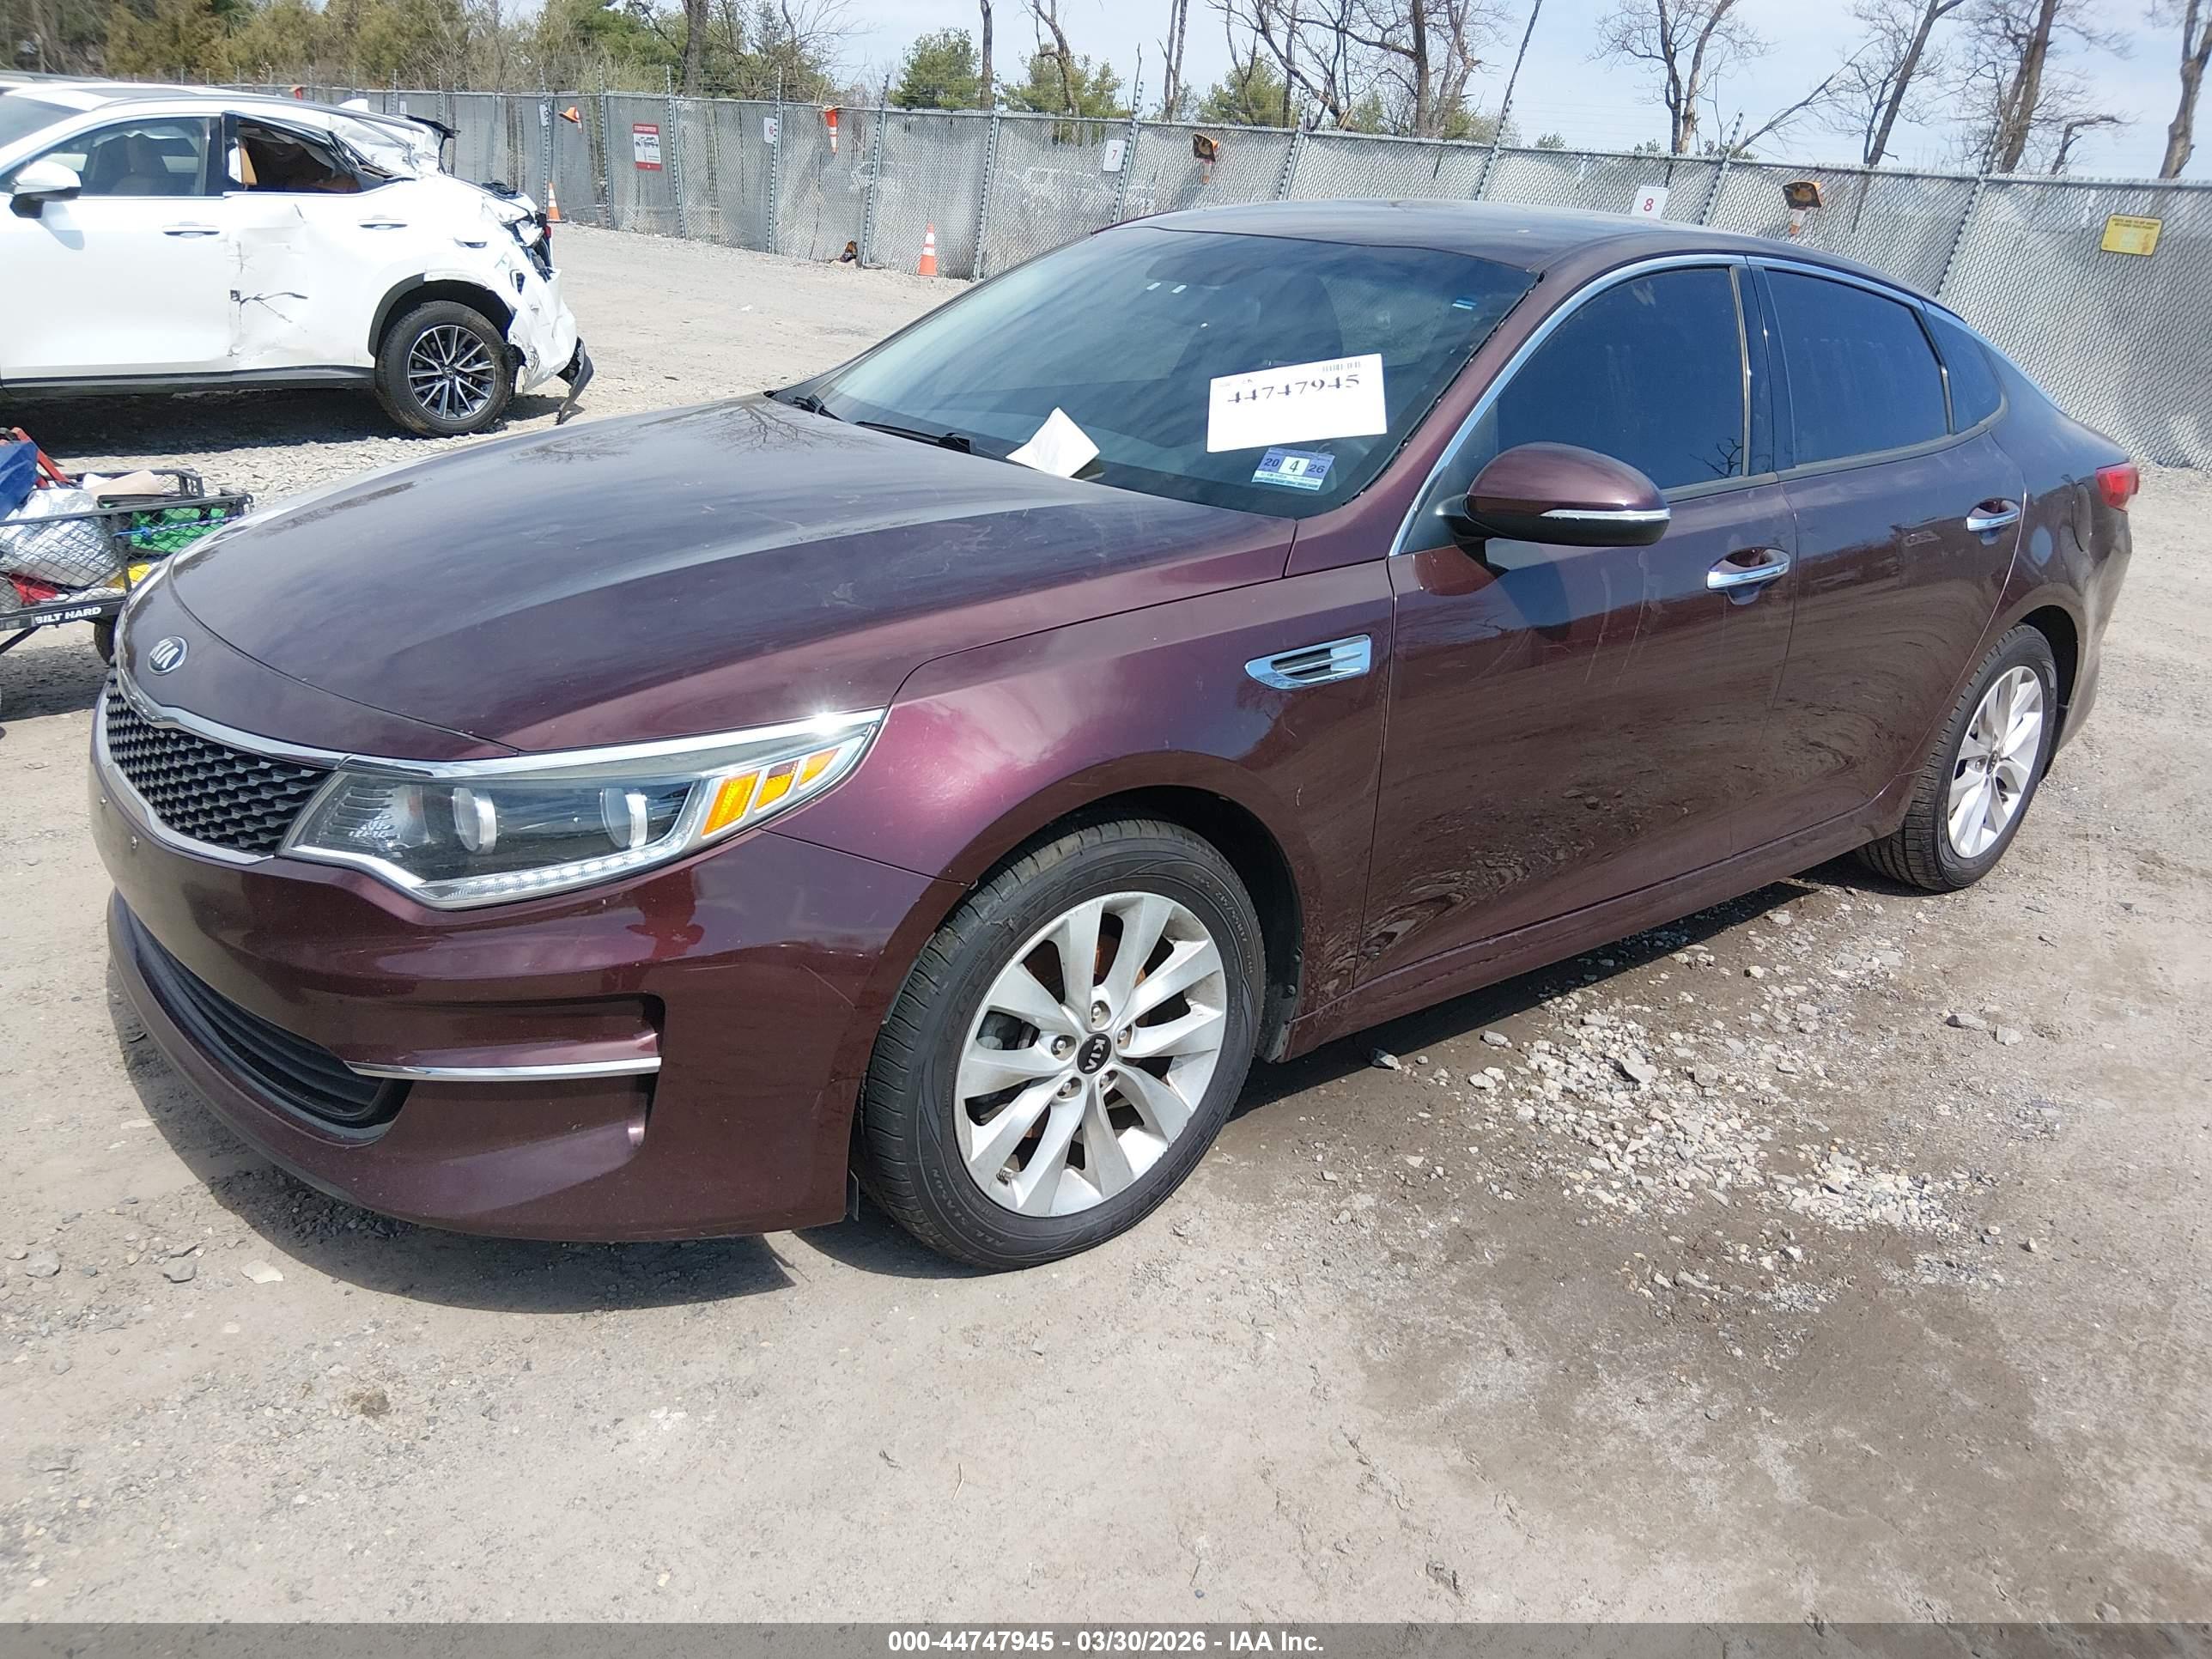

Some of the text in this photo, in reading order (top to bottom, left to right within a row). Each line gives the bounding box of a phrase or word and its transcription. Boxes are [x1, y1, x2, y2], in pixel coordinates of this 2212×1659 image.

[1111, 149, 1118, 161] 7
[1644, 198, 1654, 212] 8
[1227, 374, 1360, 404] 44747945
[1263, 458, 1326, 474] 20 4 26
[64, 606, 102, 620] HARD
[149, 638, 179, 669] KIA
[1084, 1038, 1106, 1071] KIA
